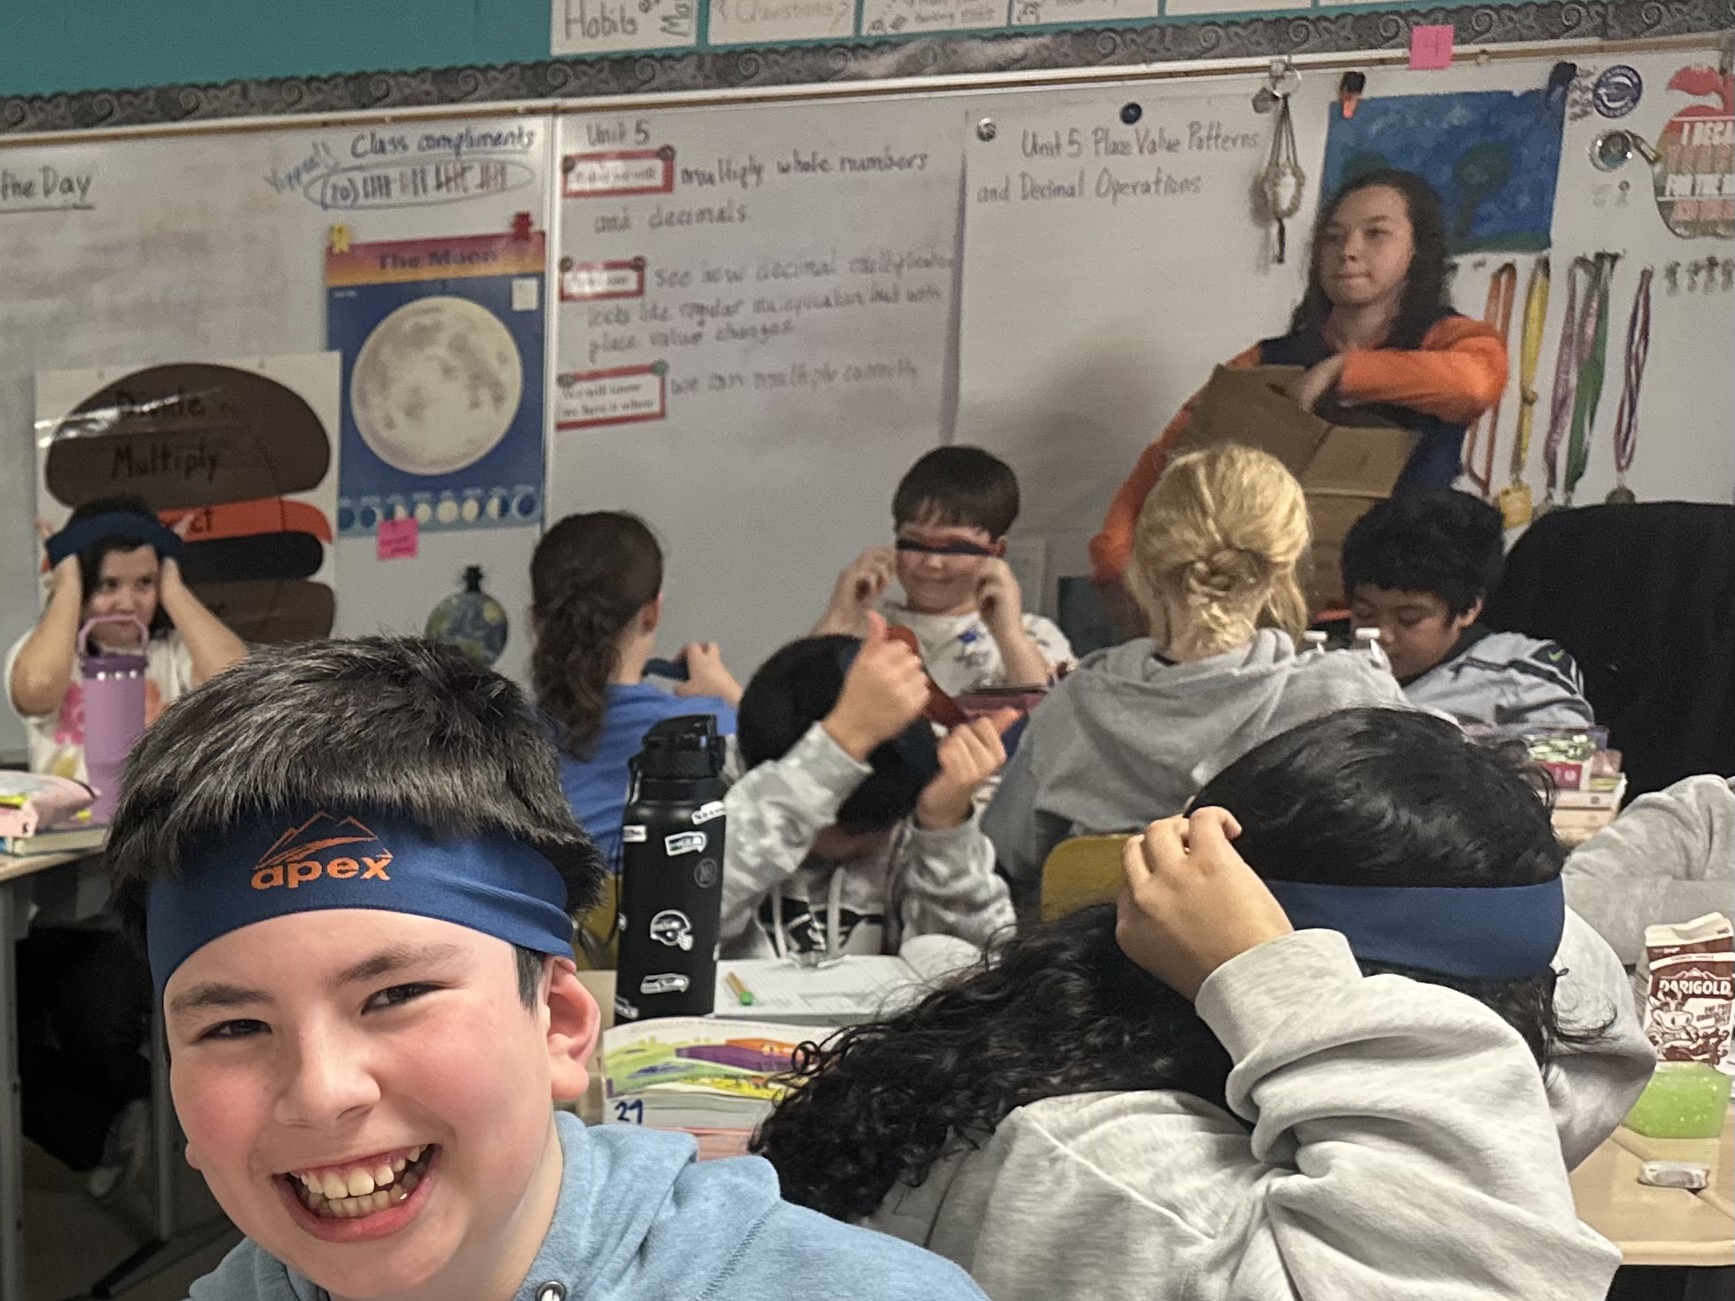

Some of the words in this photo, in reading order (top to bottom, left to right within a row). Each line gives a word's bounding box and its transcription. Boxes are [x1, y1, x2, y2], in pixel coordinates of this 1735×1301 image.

[351, 130, 409, 159] Class
[417, 126, 535, 157] compliments
[633, 120, 651, 146] 5
[1021, 130, 1063, 159] Unit
[1066, 127, 1082, 159] 5
[1134, 129, 1182, 156] Value
[1187, 119, 1260, 152] Patterns
[776, 150, 832, 176] whole
[839, 146, 930, 173] numbers
[0, 168, 38, 200] the
[42, 165, 93, 203] Day
[975, 175, 1011, 204] and
[1019, 169, 1086, 200] Decimal
[1094, 164, 1203, 206] Operations
[250, 847, 394, 890] apex
[1658, 979, 1733, 996] DARIGOLD
